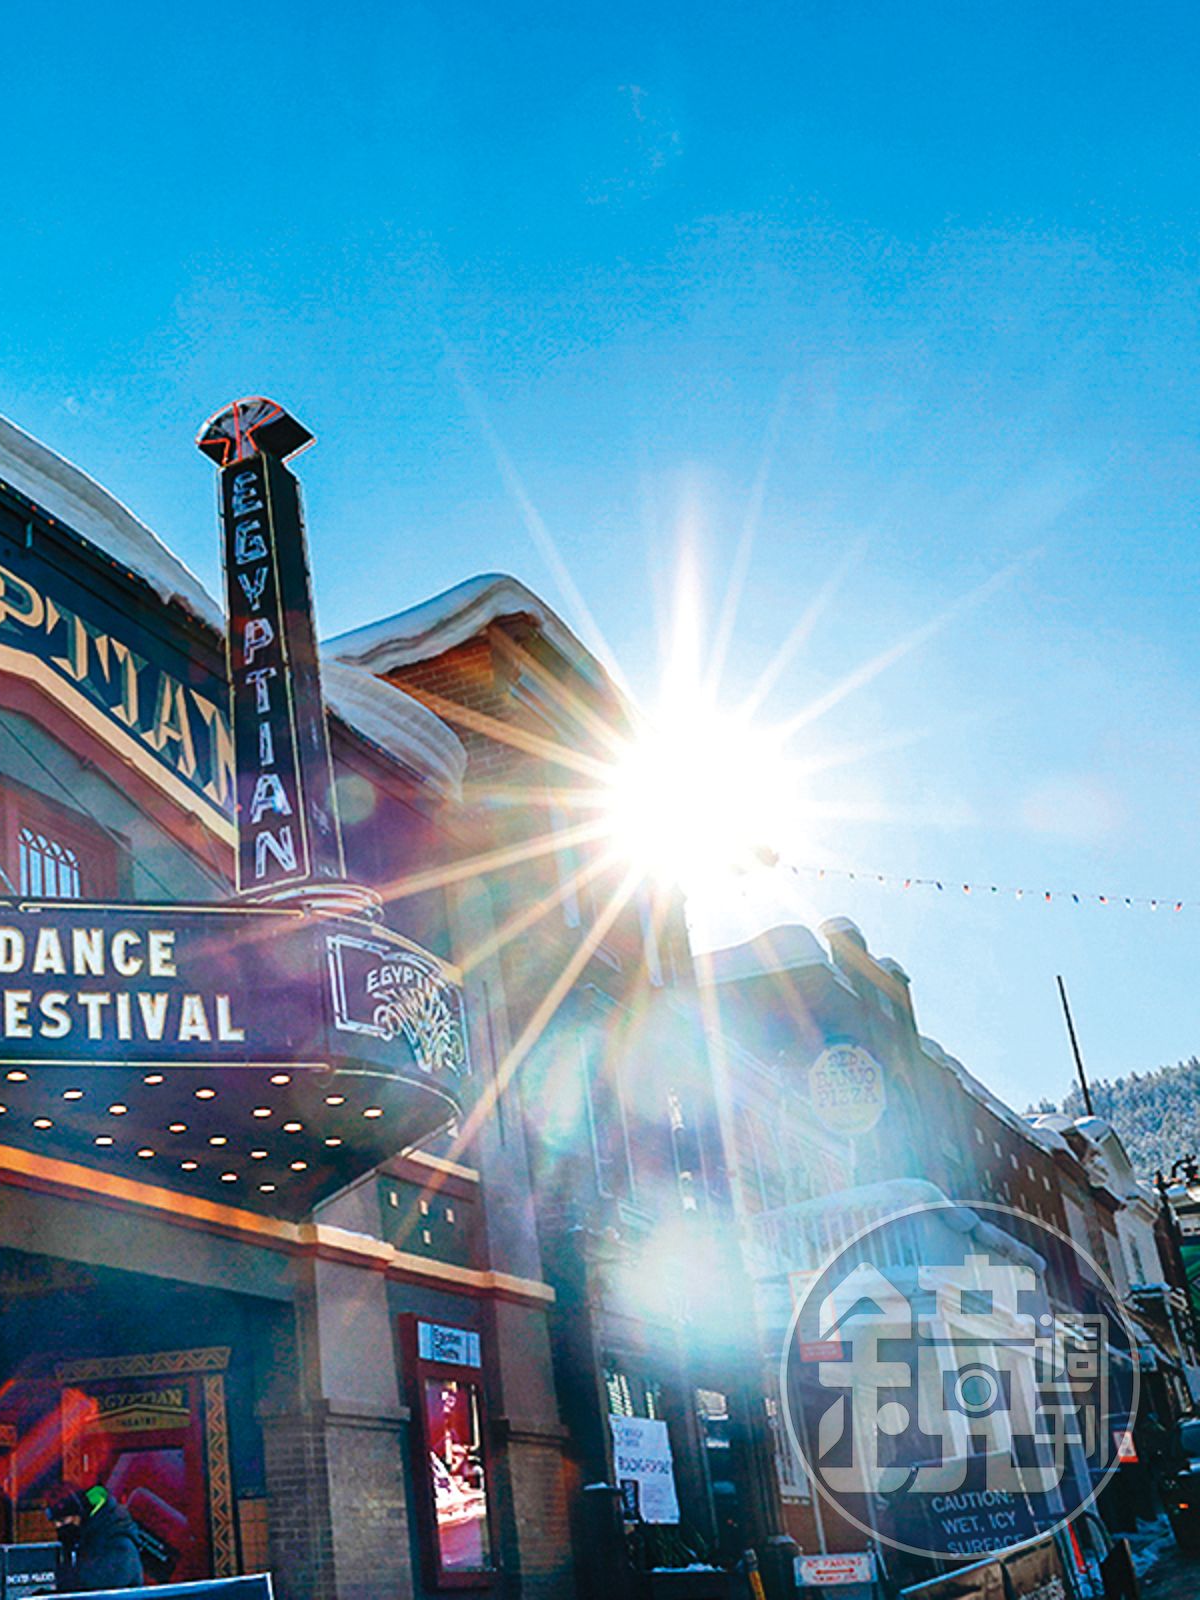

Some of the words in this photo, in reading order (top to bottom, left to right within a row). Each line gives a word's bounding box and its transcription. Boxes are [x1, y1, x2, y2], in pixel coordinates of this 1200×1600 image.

[231, 472, 296, 879] EGYPTIAN
[931, 1488, 1016, 1513] CAUTION:
[941, 1516, 985, 1536] WET,
[989, 1511, 1016, 1530] ICY
